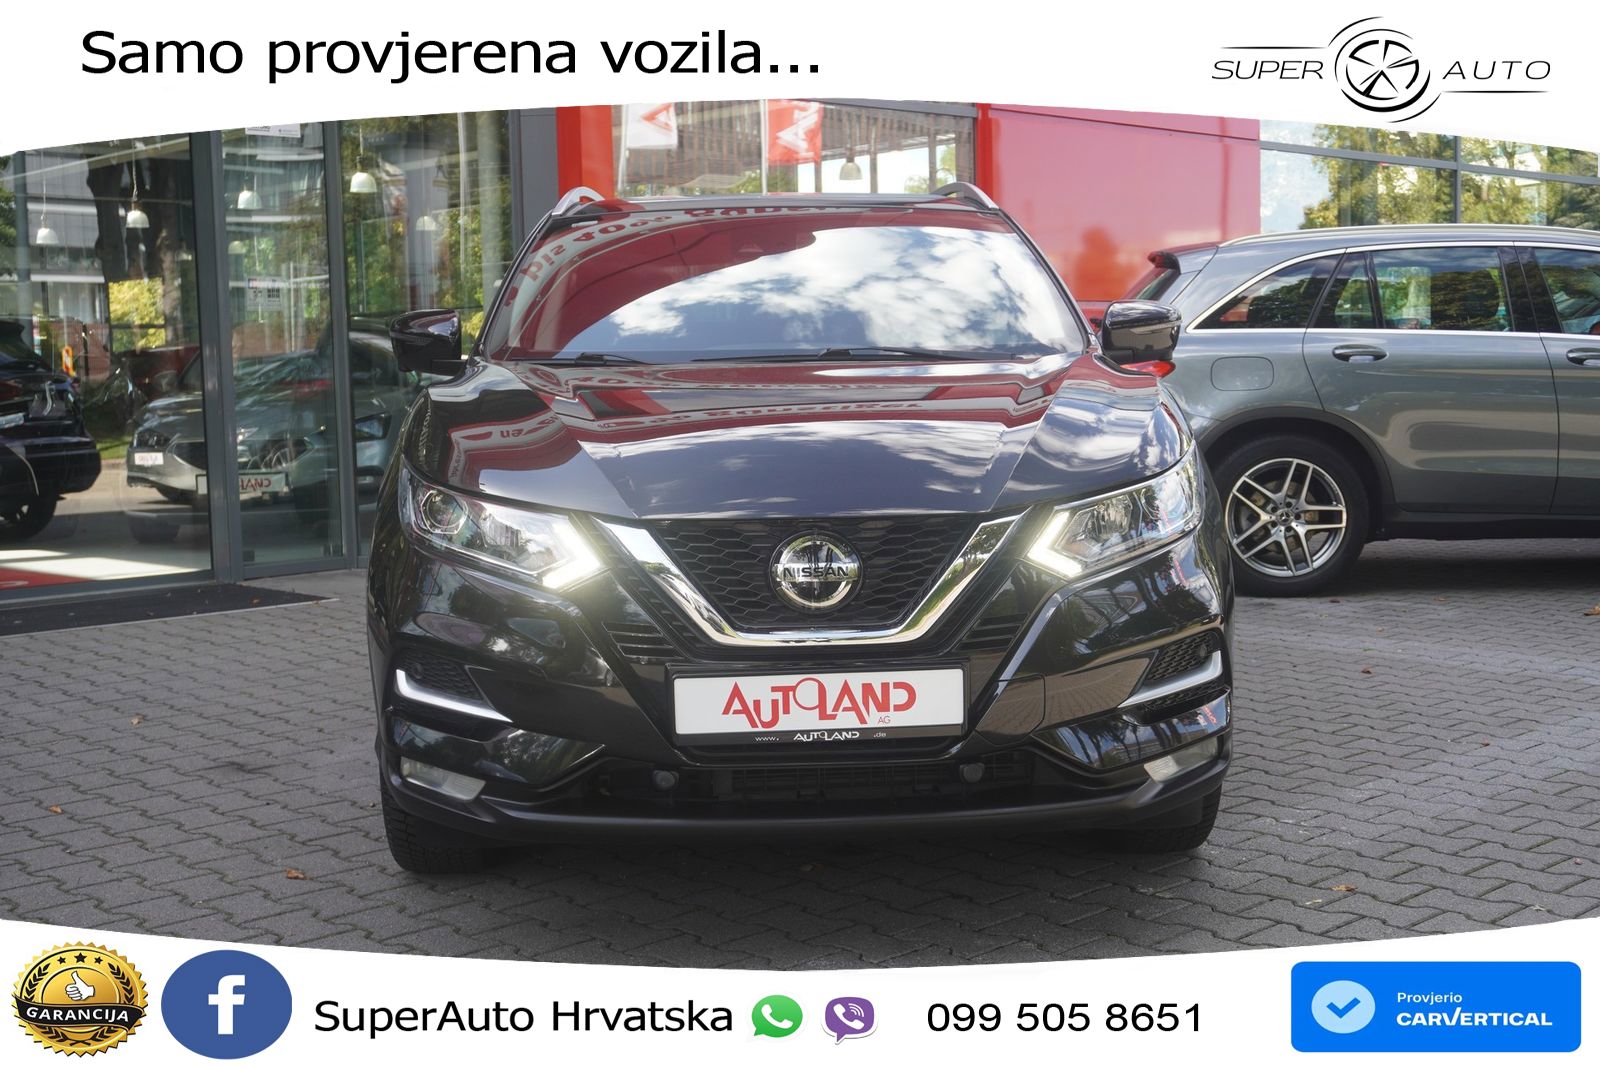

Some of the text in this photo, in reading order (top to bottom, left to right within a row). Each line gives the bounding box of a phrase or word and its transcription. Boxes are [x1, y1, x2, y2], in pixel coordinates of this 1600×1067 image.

[782, 566, 849, 578] NISSAN
[722, 677, 917, 729] AUTOLAND
[877, 716, 891, 725] AG
[793, 731, 860, 742] AUTOLAND
